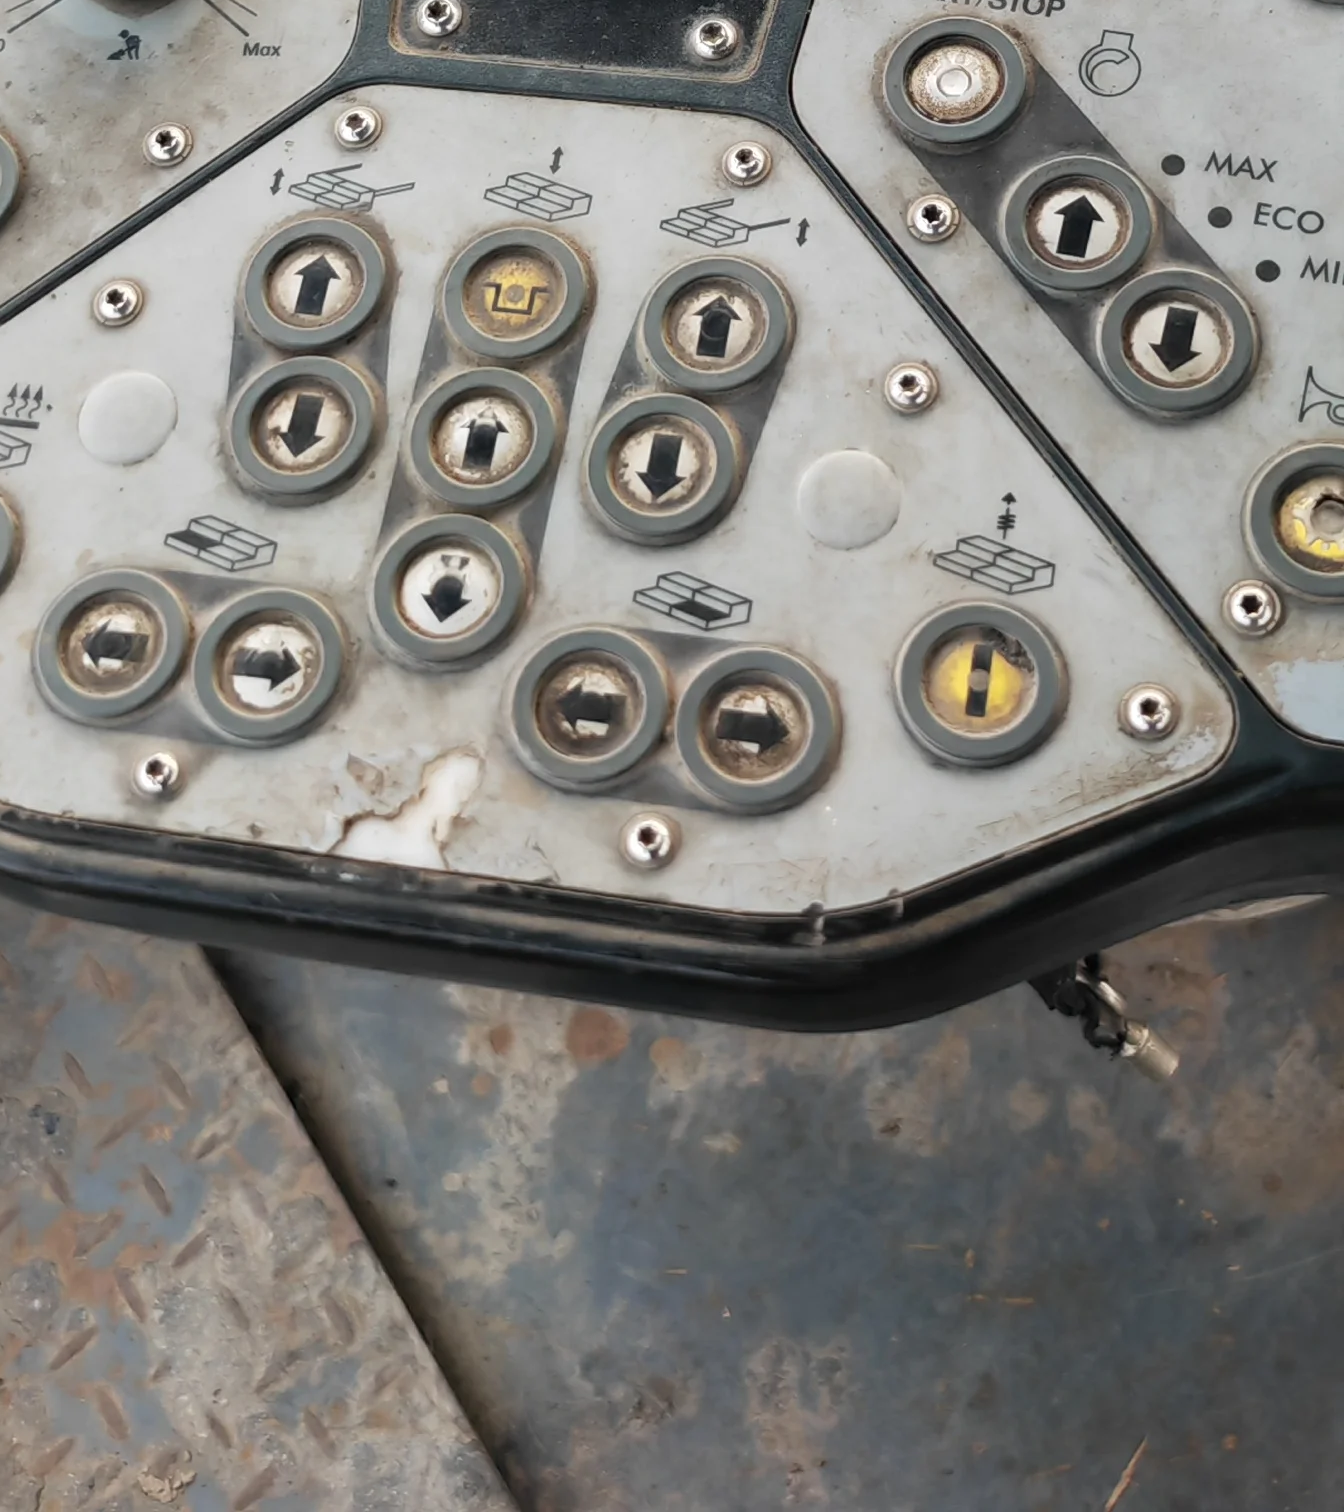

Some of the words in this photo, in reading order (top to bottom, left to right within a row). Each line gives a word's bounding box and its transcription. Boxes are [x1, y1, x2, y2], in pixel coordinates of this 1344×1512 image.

[242, 41, 282, 57] Max
[1204, 151, 1278, 183] MAX
[1253, 201, 1325, 235] ECO
